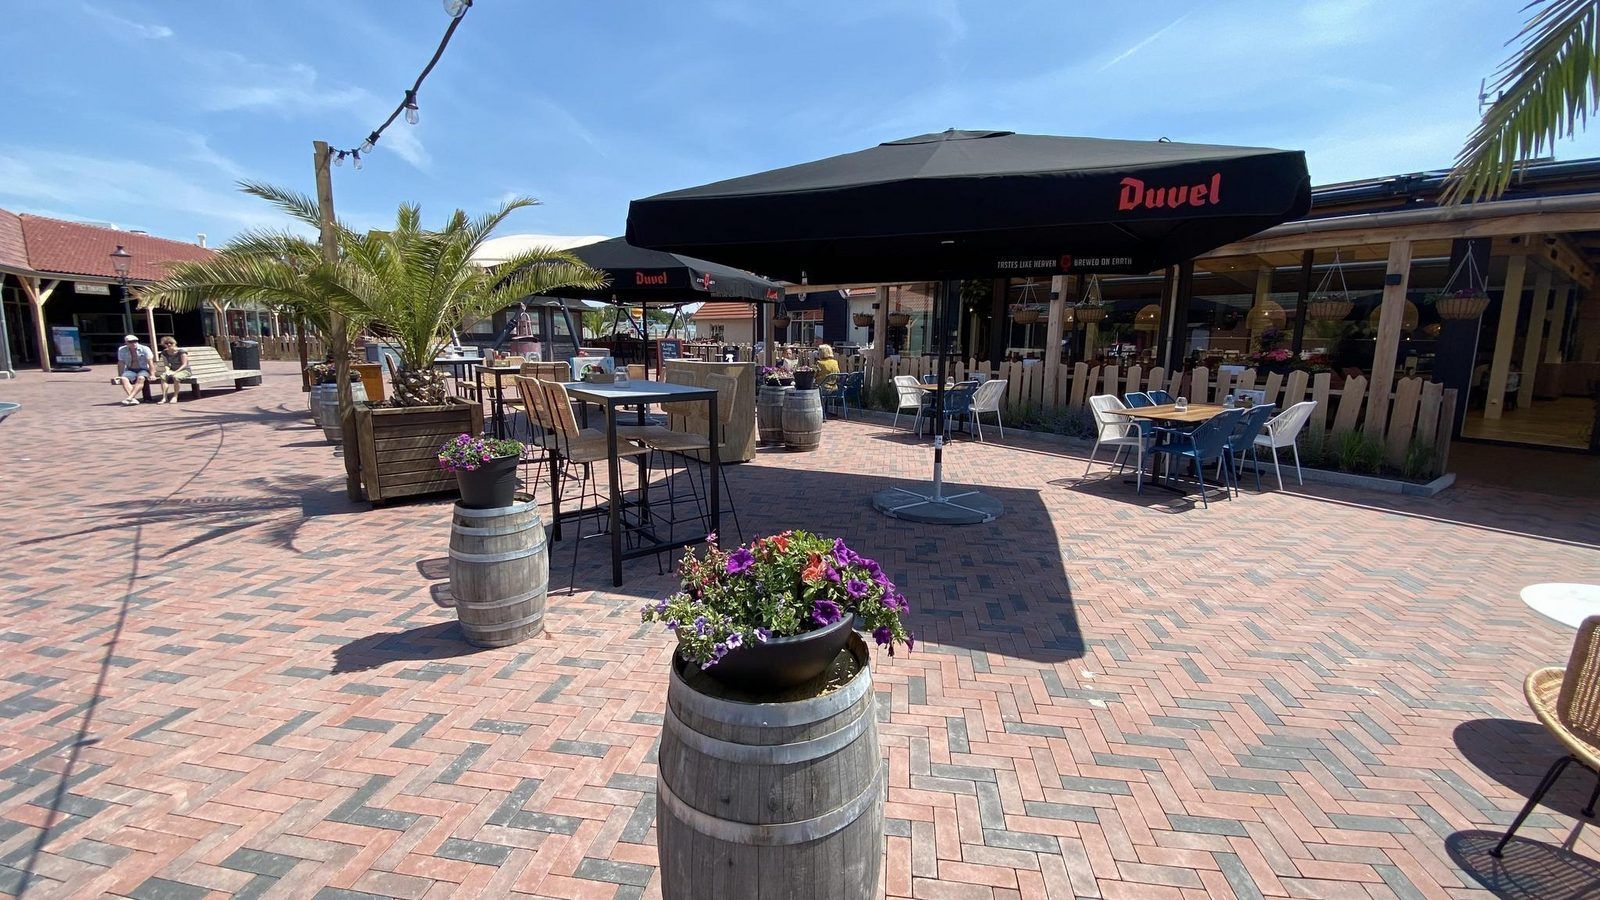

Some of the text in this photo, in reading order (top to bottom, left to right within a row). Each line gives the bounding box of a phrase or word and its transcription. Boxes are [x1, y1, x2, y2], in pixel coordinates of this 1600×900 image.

[1118, 173, 1221, 211] Duvel
[997, 259, 1057, 269] TASTES LIKE HEAVEN
[1073, 256, 1132, 267] BREWED ON EARTH
[636, 271, 667, 285] Duvel
